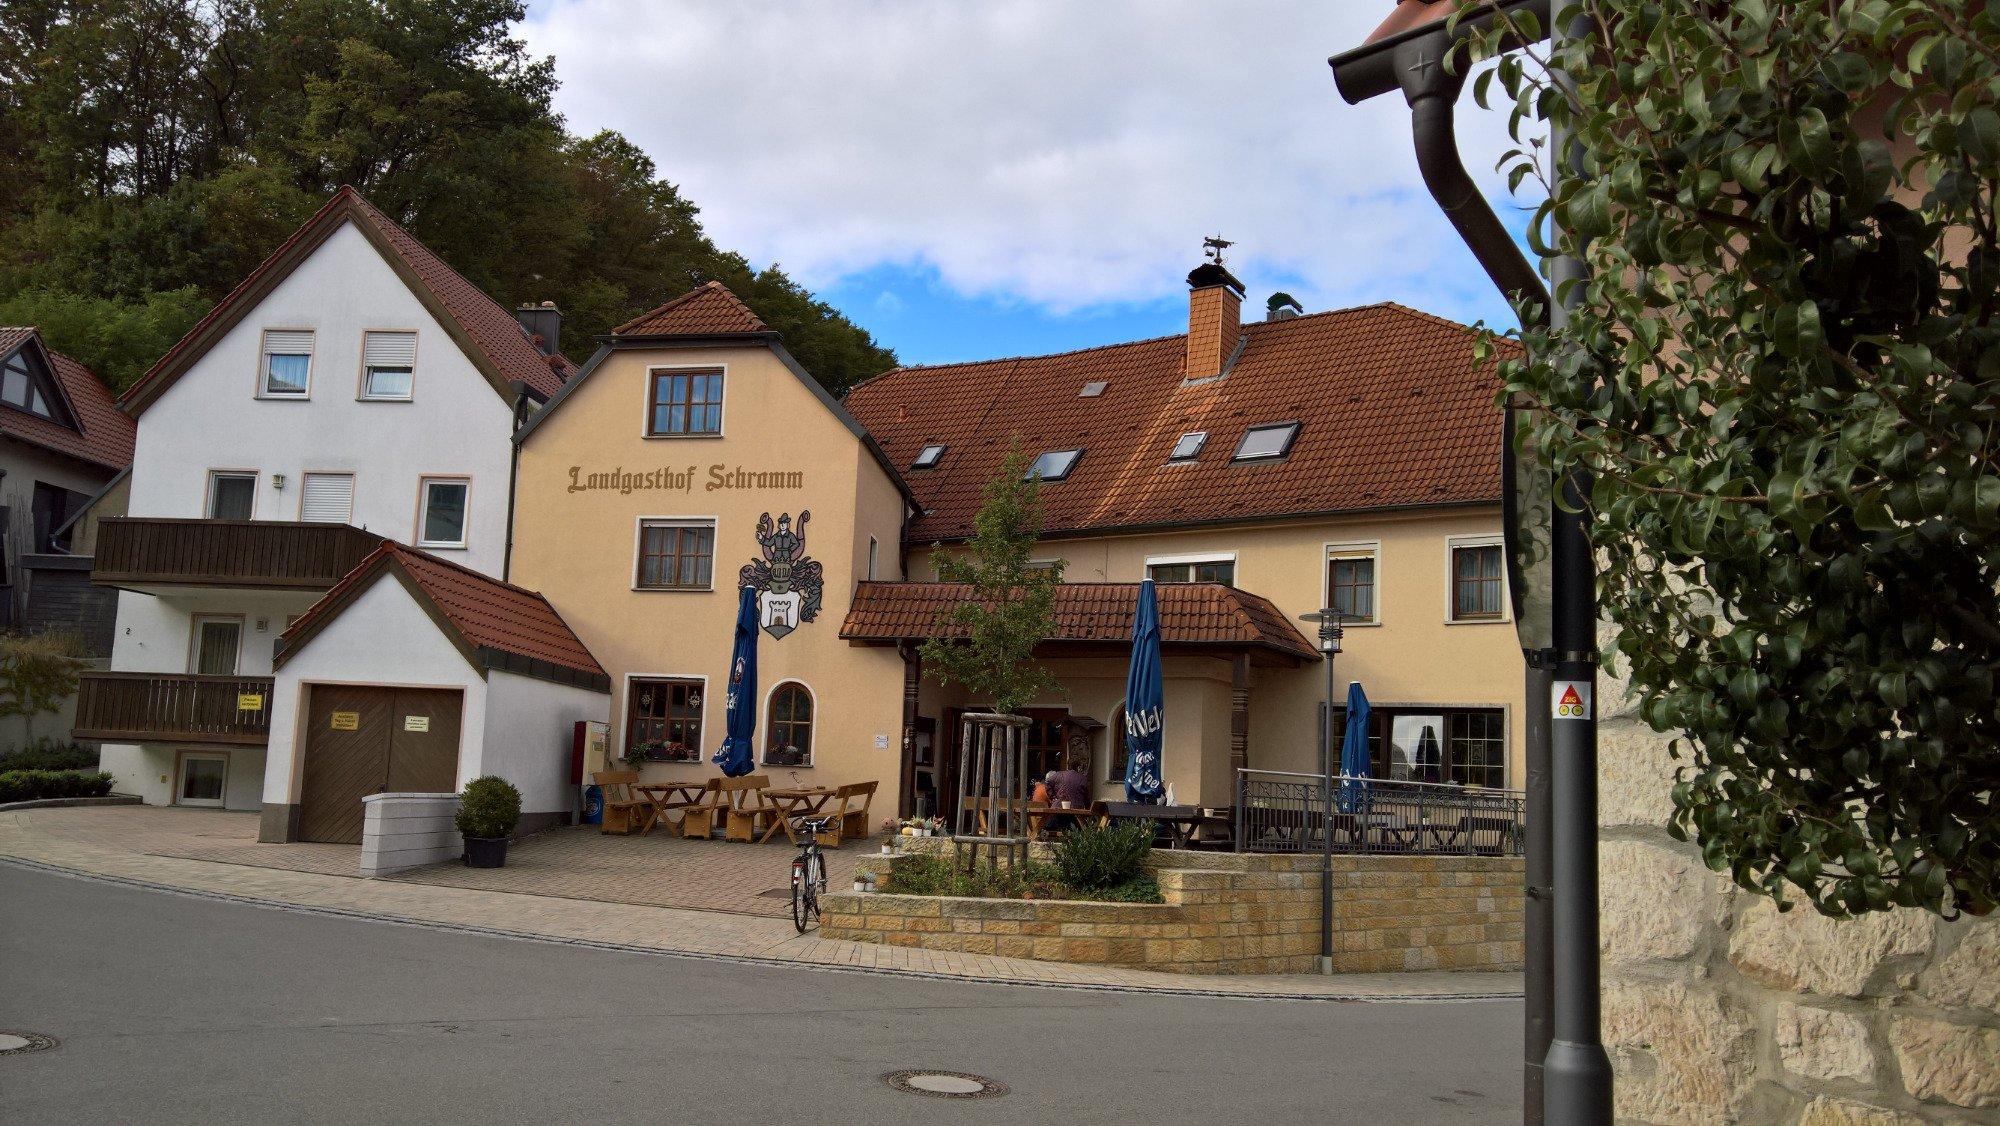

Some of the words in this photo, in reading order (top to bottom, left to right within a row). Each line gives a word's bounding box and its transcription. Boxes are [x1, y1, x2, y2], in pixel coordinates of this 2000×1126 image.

[567, 465, 697, 495] Landgasthof
[705, 463, 804, 492] Schramm
[126, 627, 131, 635] 2
